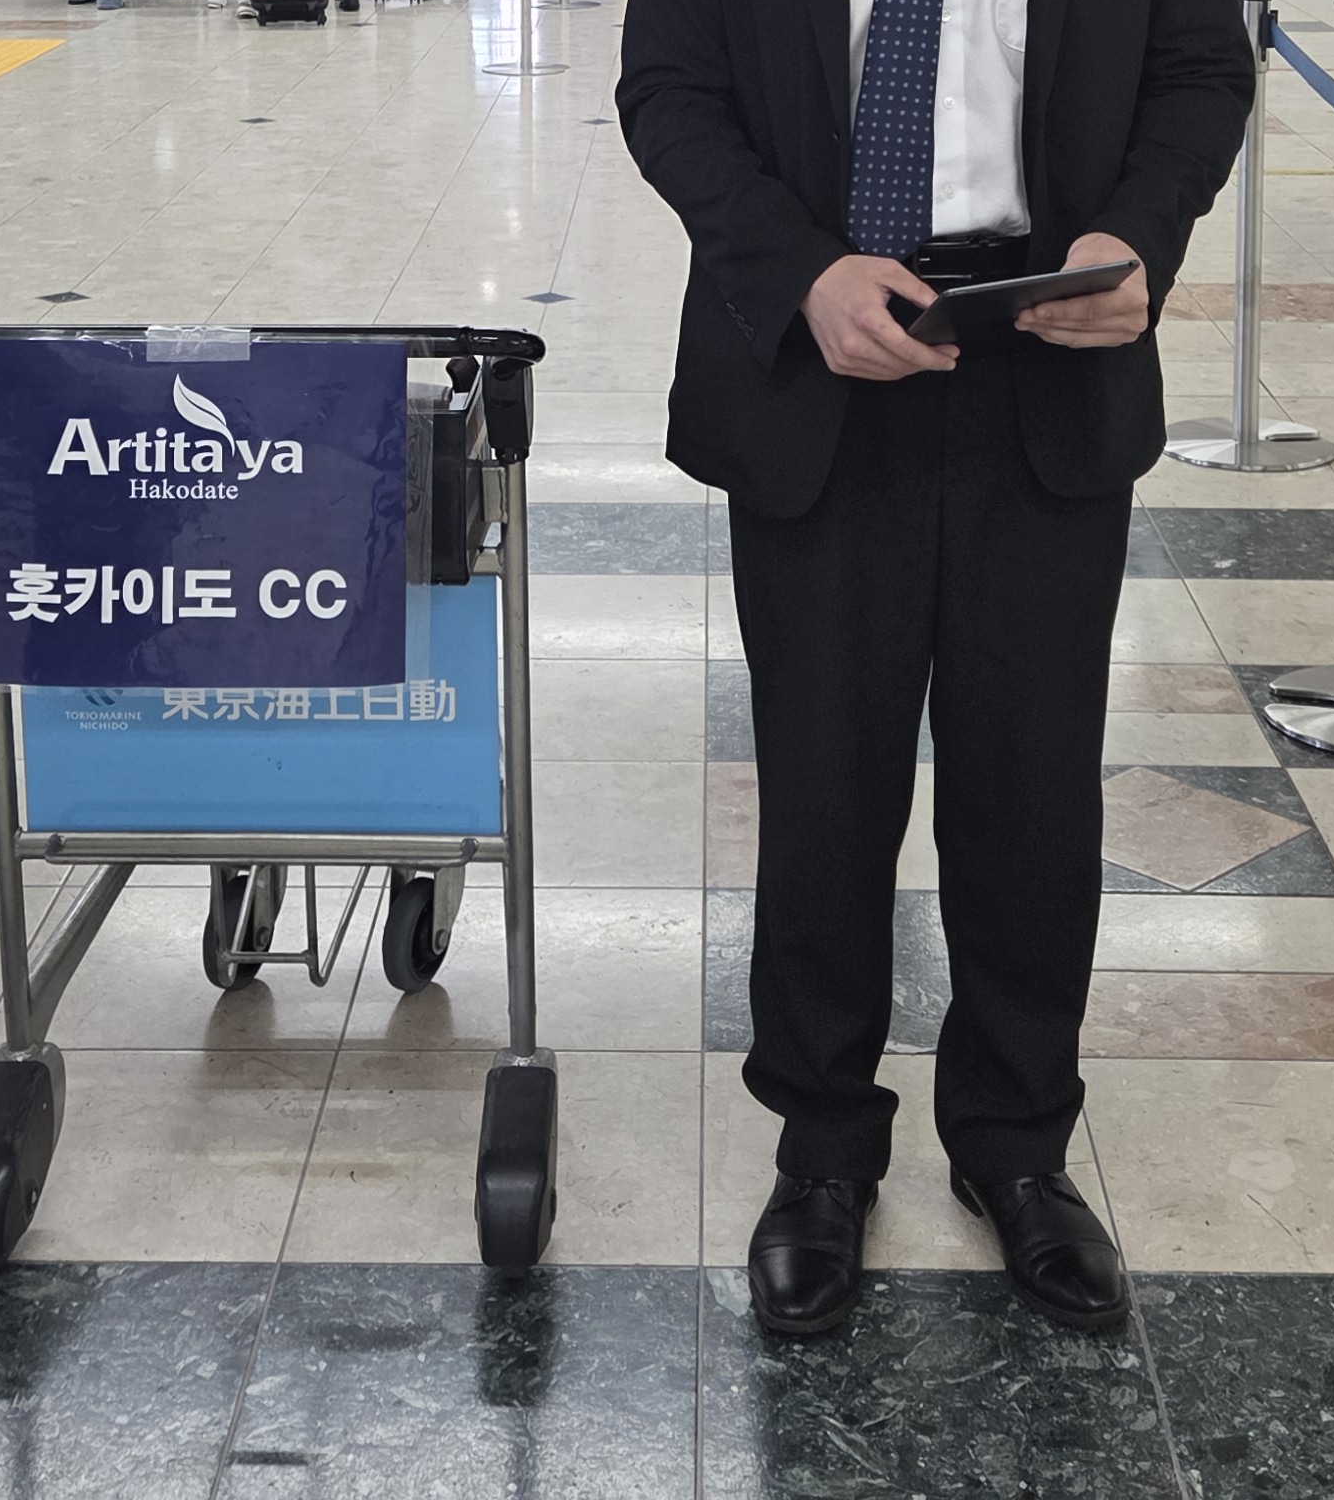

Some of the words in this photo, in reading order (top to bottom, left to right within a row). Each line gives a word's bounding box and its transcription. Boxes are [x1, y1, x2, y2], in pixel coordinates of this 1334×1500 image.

[47, 417, 304, 479] Artitaya
[128, 478, 239, 501] Hakodate
[5, 562, 237, 624] 홋카이도
[258, 569, 348, 620] CC
[65, 711, 98, 721] TOKIO
[99, 711, 142, 721] MARINE
[162, 680, 457, 723] 東京海上日動
[80, 721, 128, 731] NICHIDO
